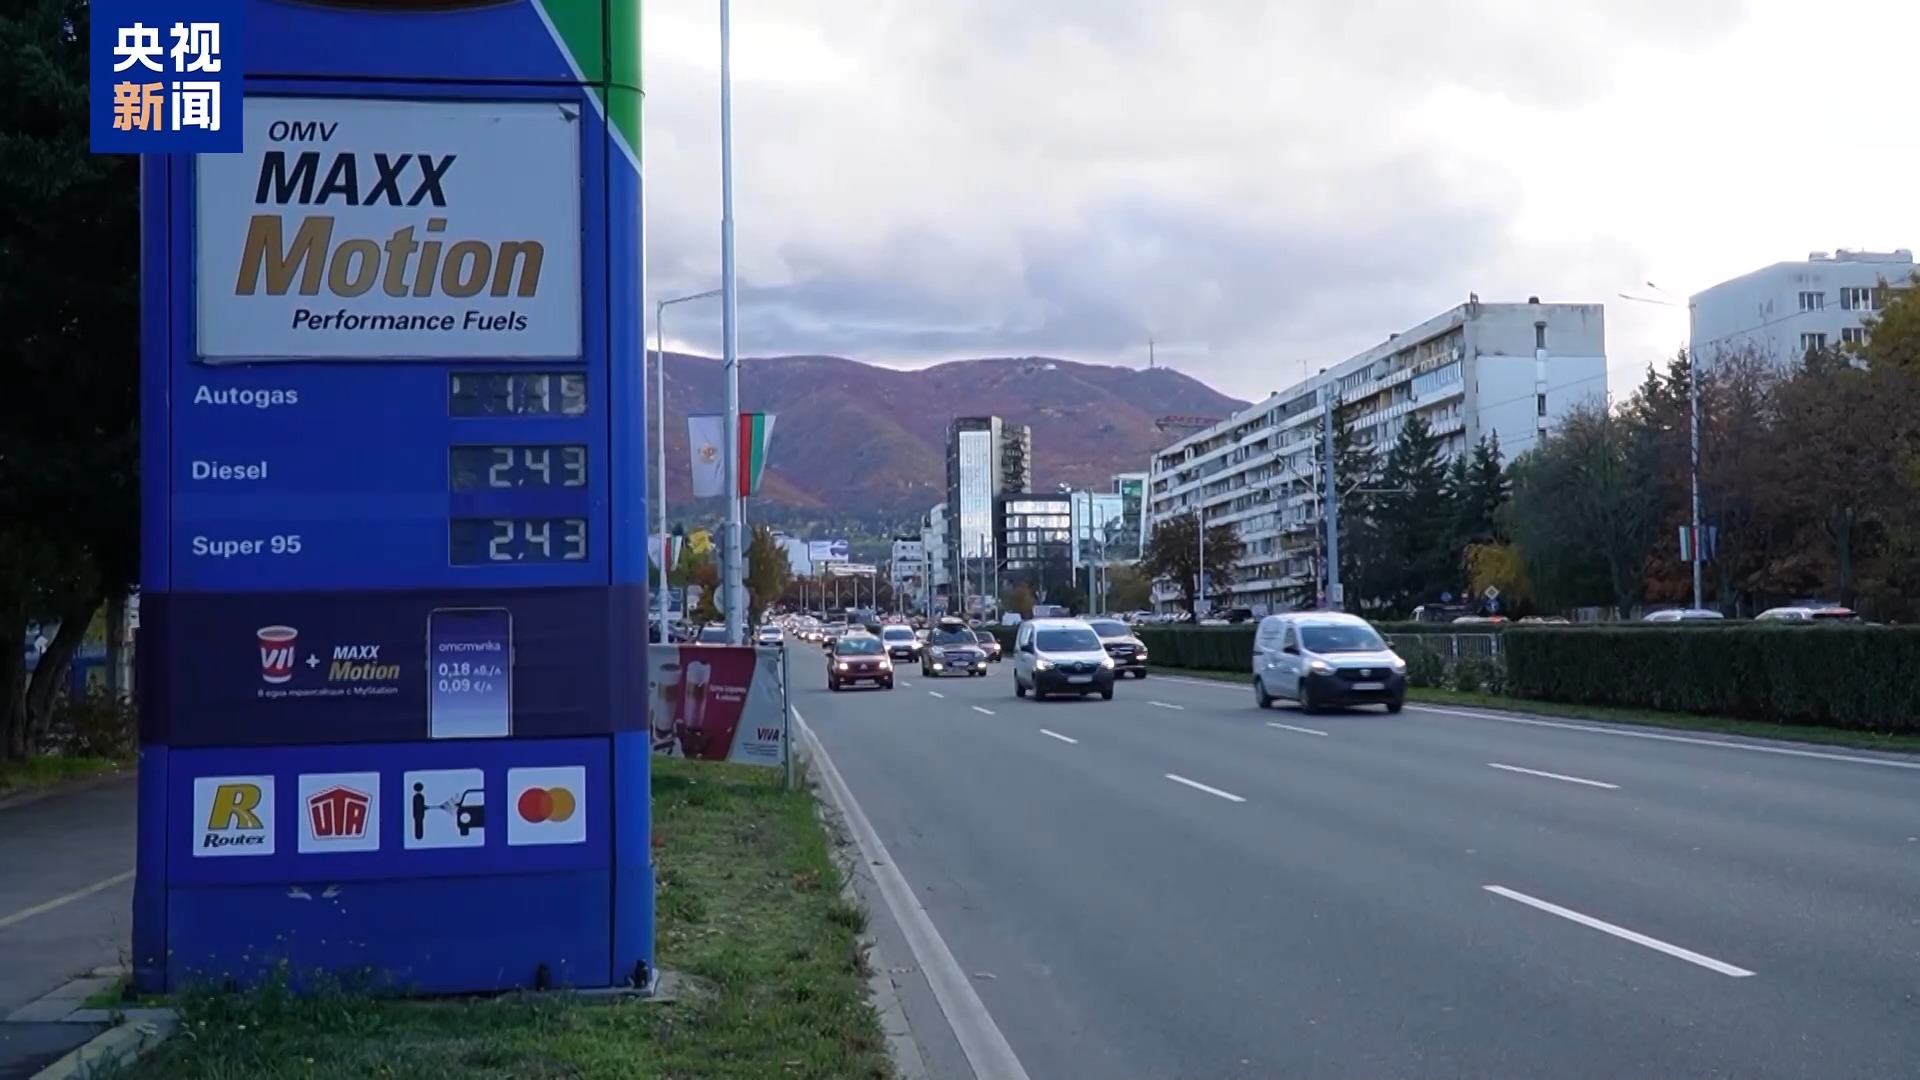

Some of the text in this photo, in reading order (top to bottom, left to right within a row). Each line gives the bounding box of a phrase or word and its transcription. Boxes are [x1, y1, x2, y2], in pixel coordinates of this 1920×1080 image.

[268, 121, 338, 142] OMV
[255, 151, 456, 207] MAXX
[235, 214, 545, 299] Motion
[292, 309, 528, 332] Performance Fuels
[193, 386, 298, 409] Autogas
[192, 447, 586, 488] Diesel 2,43
[192, 521, 586, 561] Super 95 2,43
[333, 645, 381, 660] MAXX
[328, 661, 400, 681] Motion
[438, 662, 471, 678] 0,18
[438, 678, 471, 694] 0,09
[757, 728, 780, 742] VIVA
[310, 788, 368, 837] UTA
[203, 832, 264, 848] Routex
